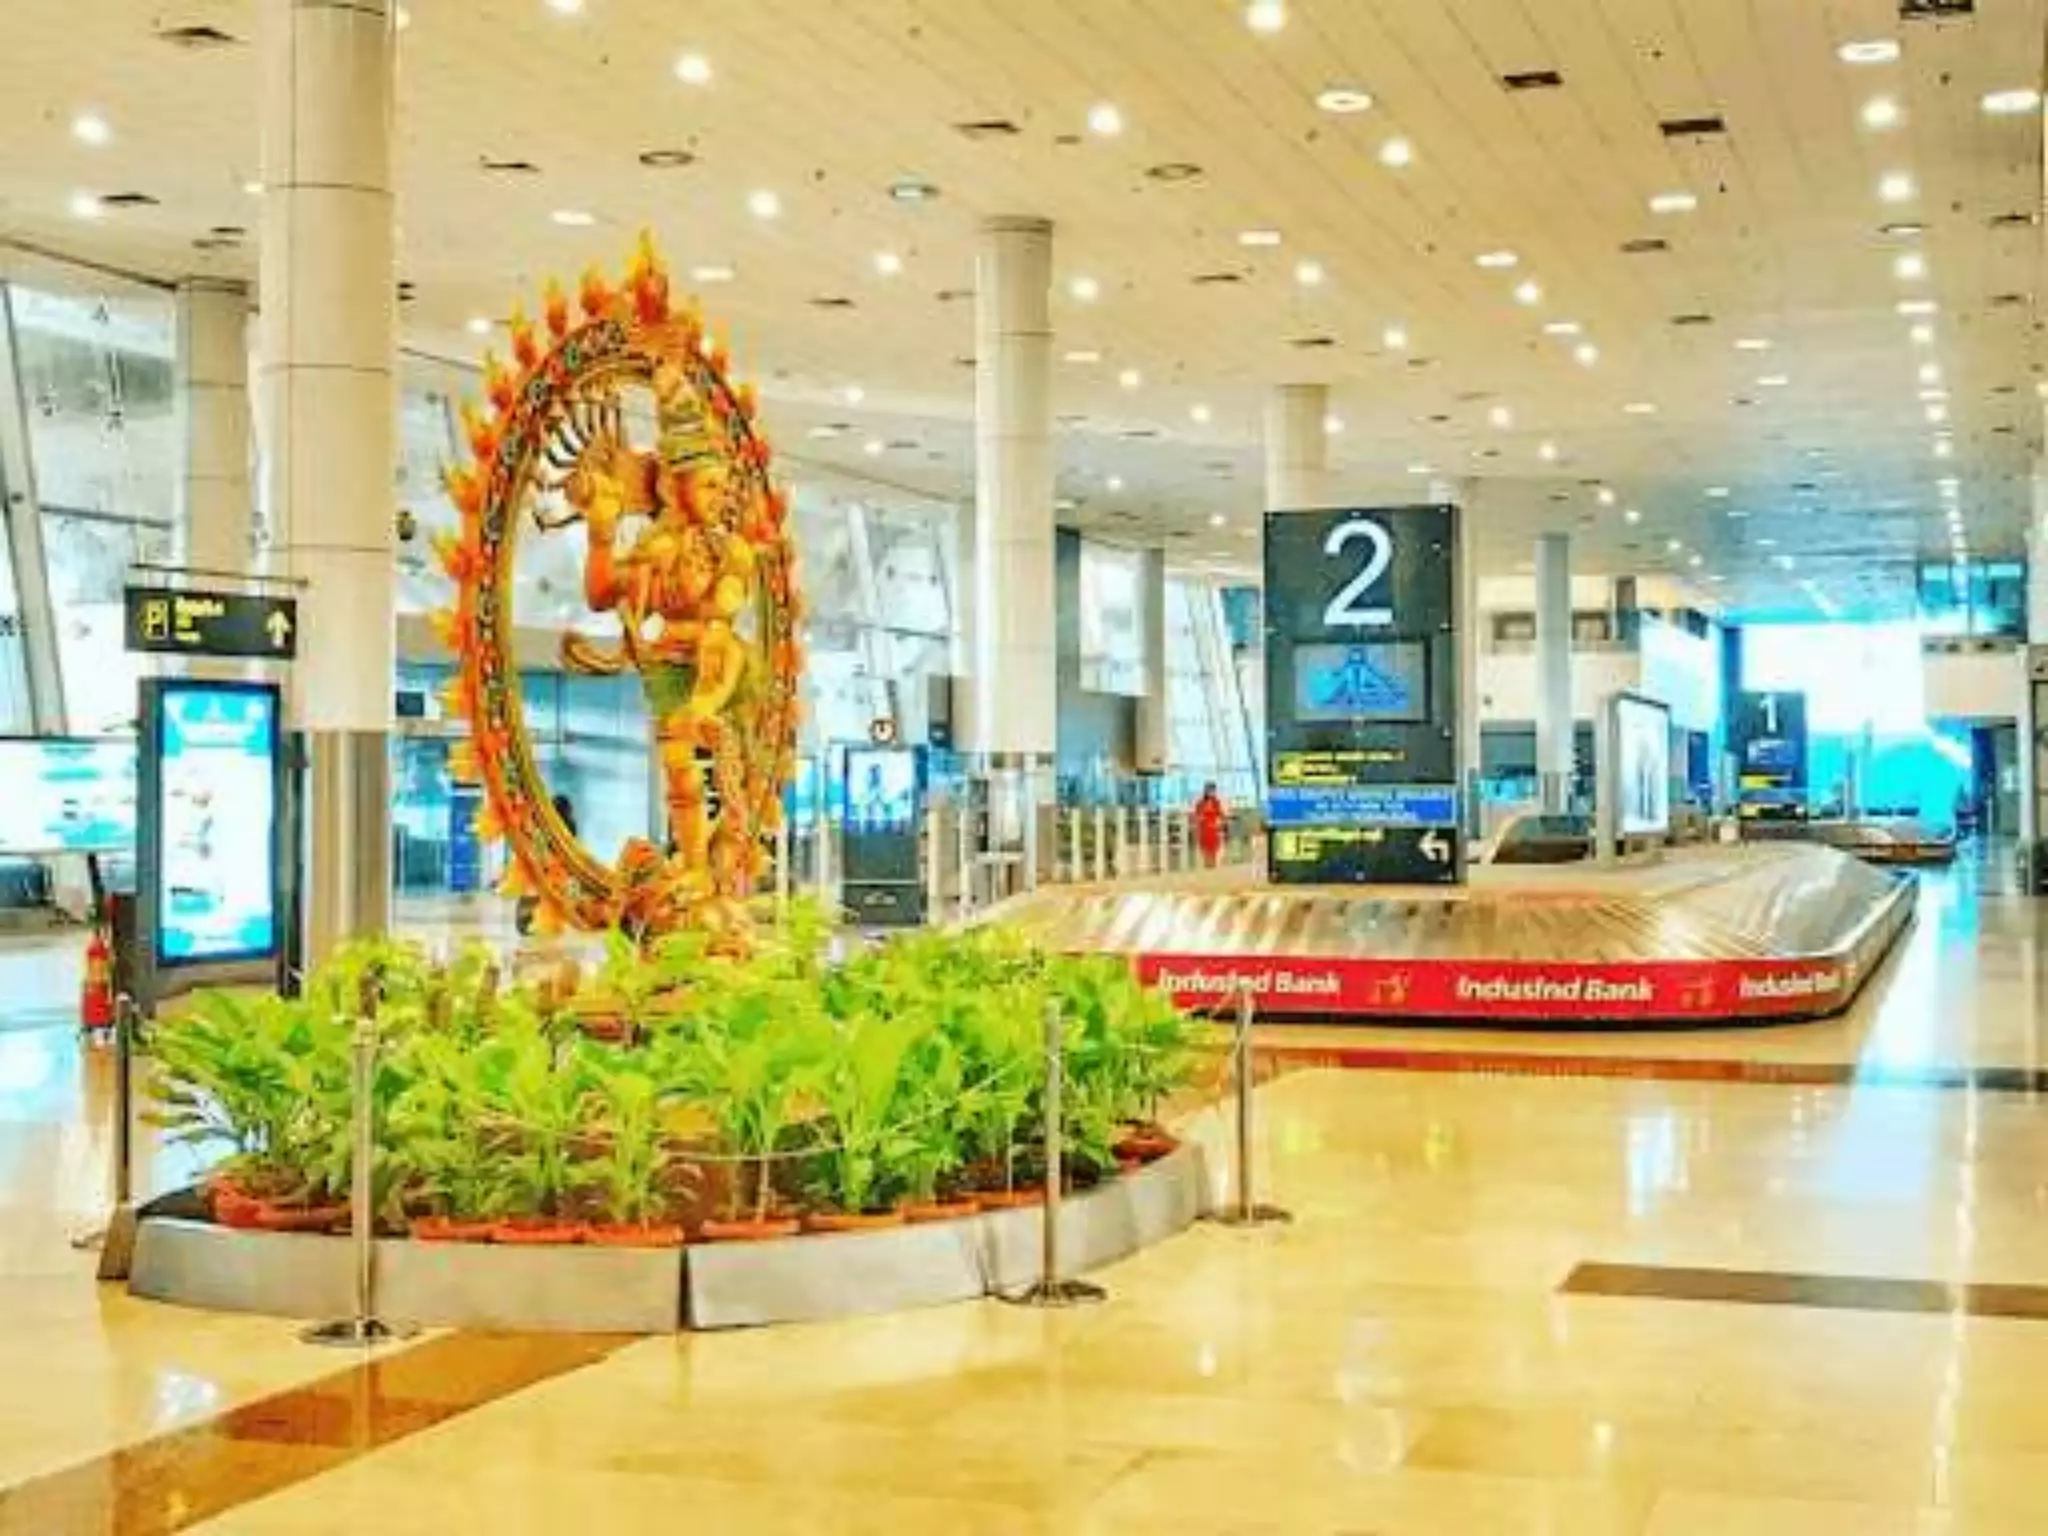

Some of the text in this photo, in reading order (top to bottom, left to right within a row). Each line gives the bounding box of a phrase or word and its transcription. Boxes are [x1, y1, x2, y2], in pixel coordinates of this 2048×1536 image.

[1323, 519, 1393, 625] 2
[1759, 694, 1777, 732] 1
[1275, 970, 1342, 993] Bank
[1456, 974, 1656, 1001] IndusInd Bank
